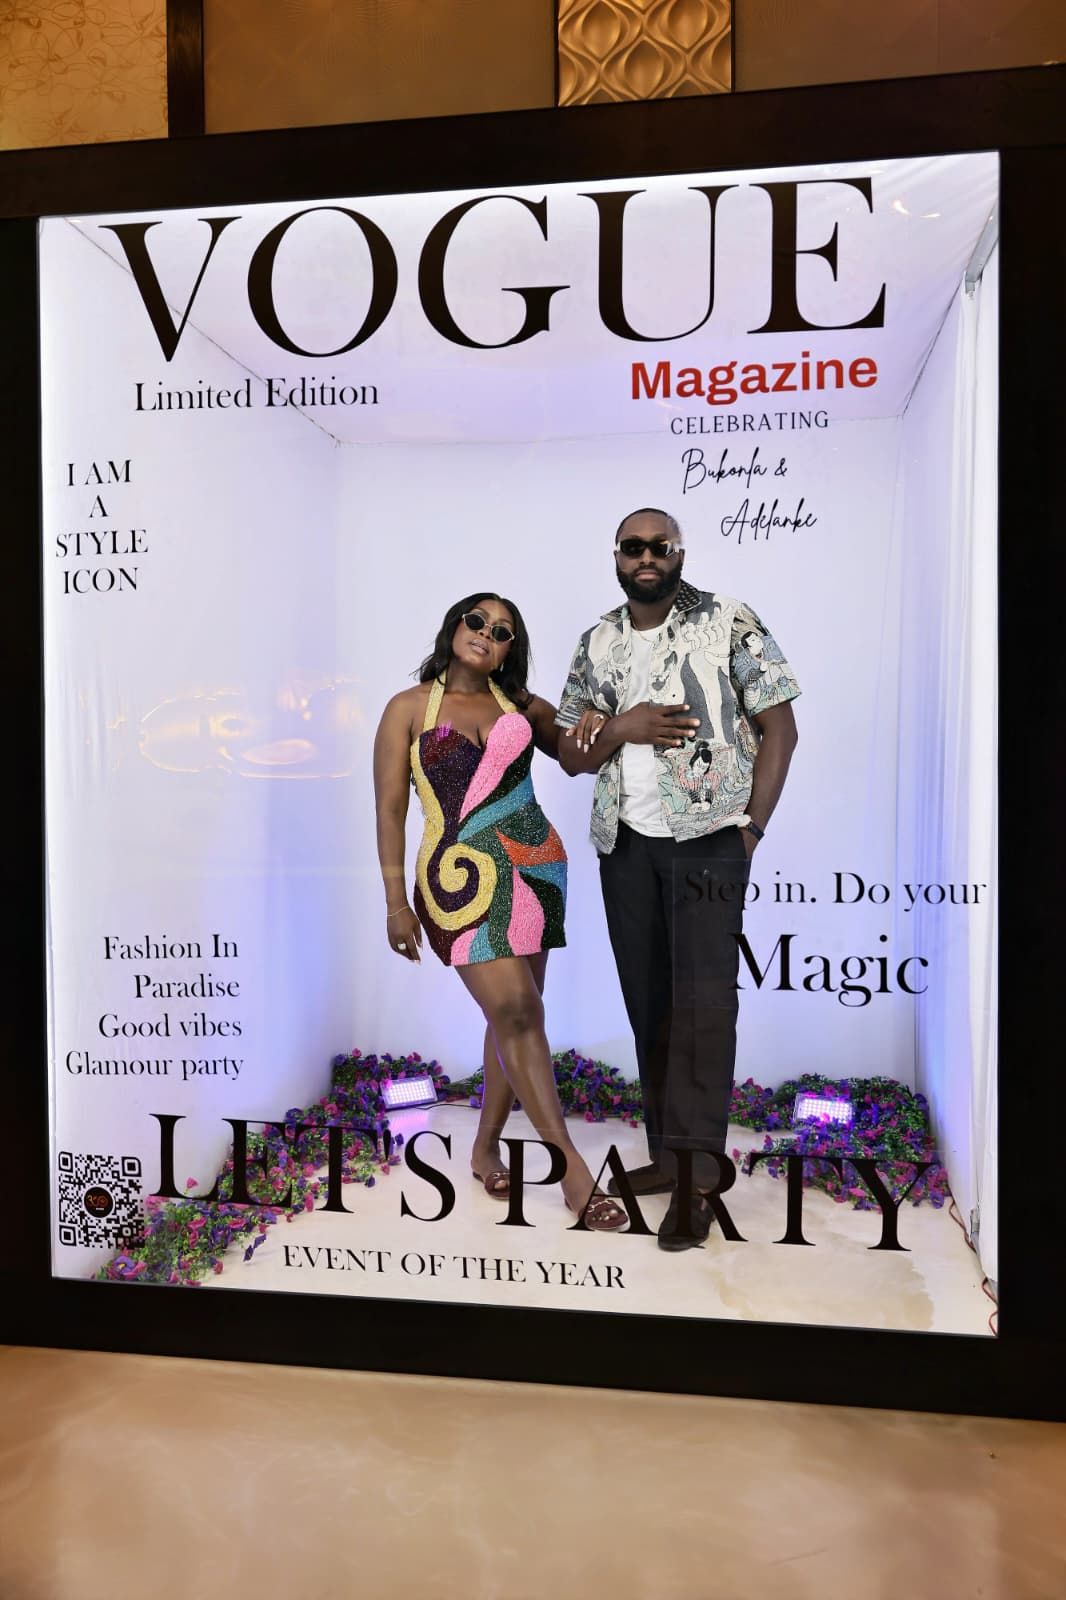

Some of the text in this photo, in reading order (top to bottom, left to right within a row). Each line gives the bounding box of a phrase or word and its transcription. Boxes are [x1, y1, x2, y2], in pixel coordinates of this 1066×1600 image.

[99, 177, 888, 363] VOGUE
[630, 351, 879, 406] Magazine
[135, 376, 380, 412] Limited Edition
[670, 410, 830, 435] CELEBRATING
[67, 459, 132, 487] I AM
[773, 457, 789, 477] &
[88, 494, 109, 519] A
[55, 528, 149, 558] STYLE
[63, 567, 139, 595] ICON
[684, 870, 987, 913] Step in. Do your
[103, 933, 240, 960] Fashion In
[133, 972, 241, 999] Paradise
[729, 933, 929, 1008] Magic
[98, 1012, 243, 1038] Good vibes
[65, 1050, 244, 1081] Glamour party
[149, 1113, 938, 1252] LET'S PARTY
[283, 1244, 626, 1289] EVENT OF THE YEAR
